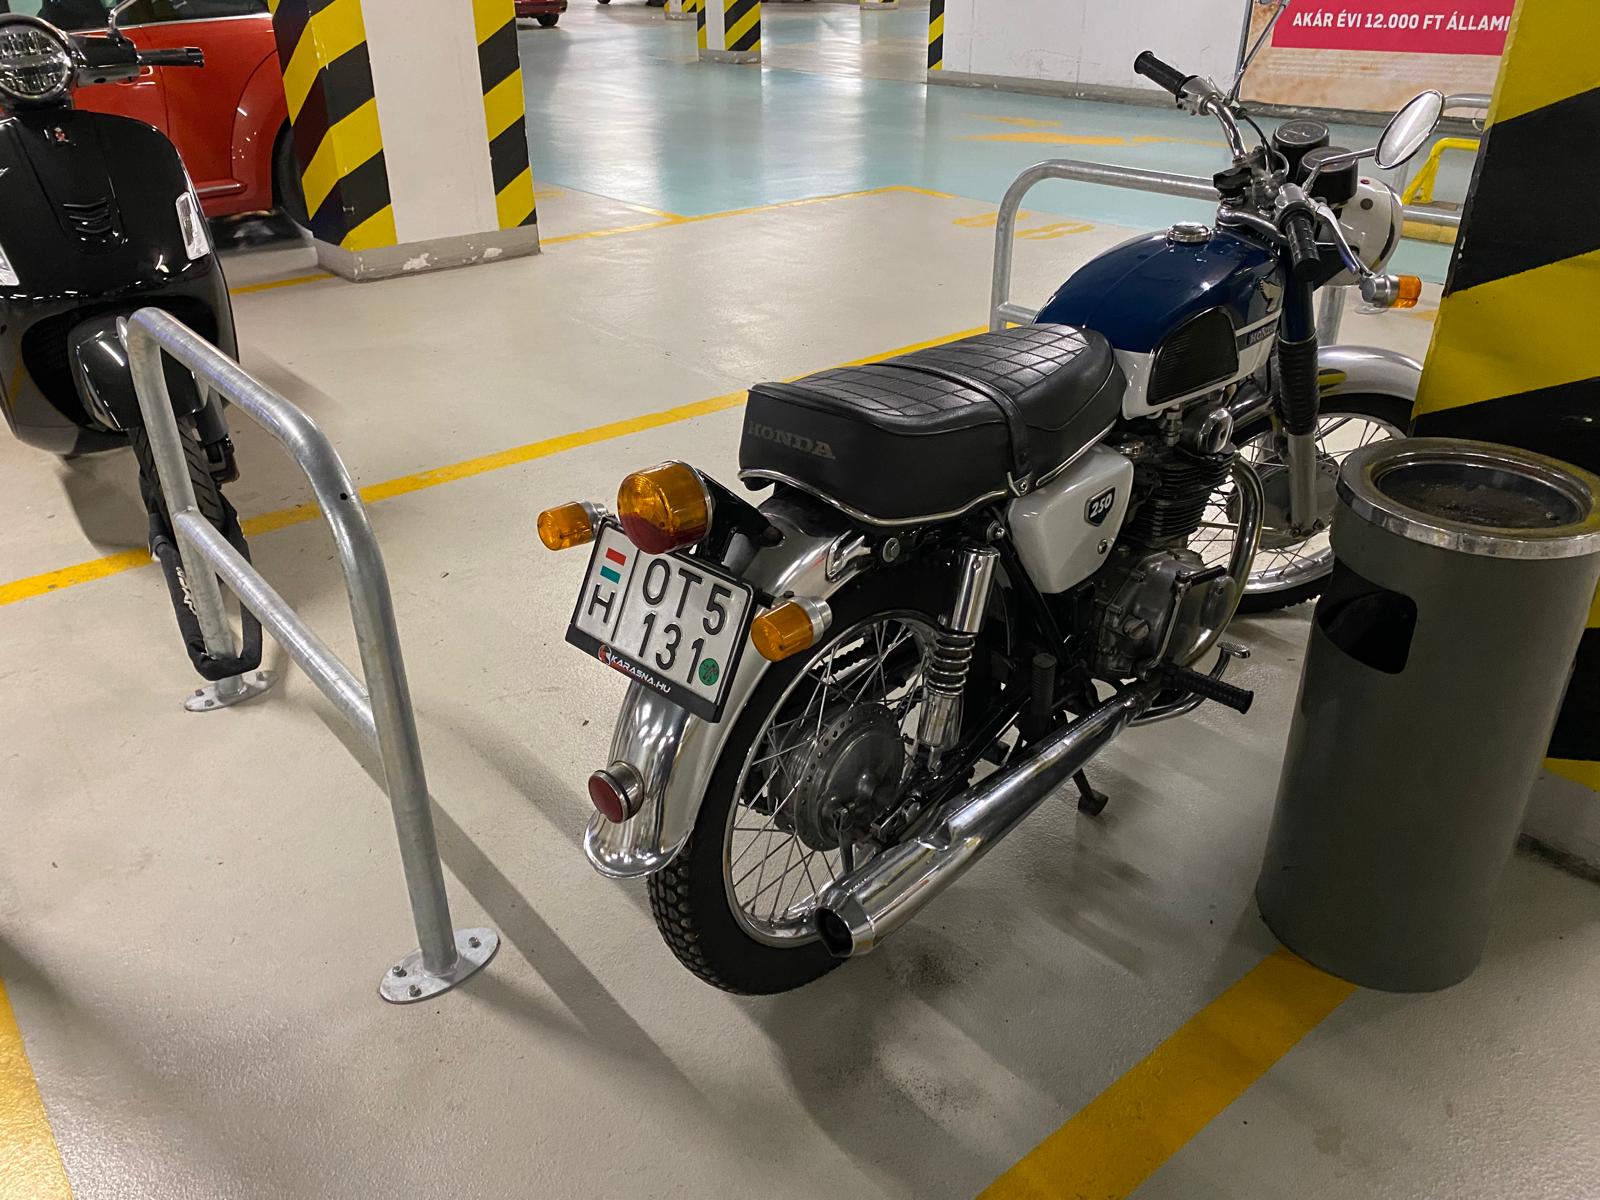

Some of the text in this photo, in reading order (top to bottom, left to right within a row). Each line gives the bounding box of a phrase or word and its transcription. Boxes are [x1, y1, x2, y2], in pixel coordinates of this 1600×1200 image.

[1292, 9, 1510, 32] AKÁR ÉVI 12.000 FT ÁLLAMI
[746, 420, 836, 460] HONDA
[1090, 493, 1113, 518] 250
[588, 583, 616, 624] H
[642, 557, 732, 636] OT5
[638, 612, 705, 685] 131
[610, 654, 671, 693] KARASNA.HU
